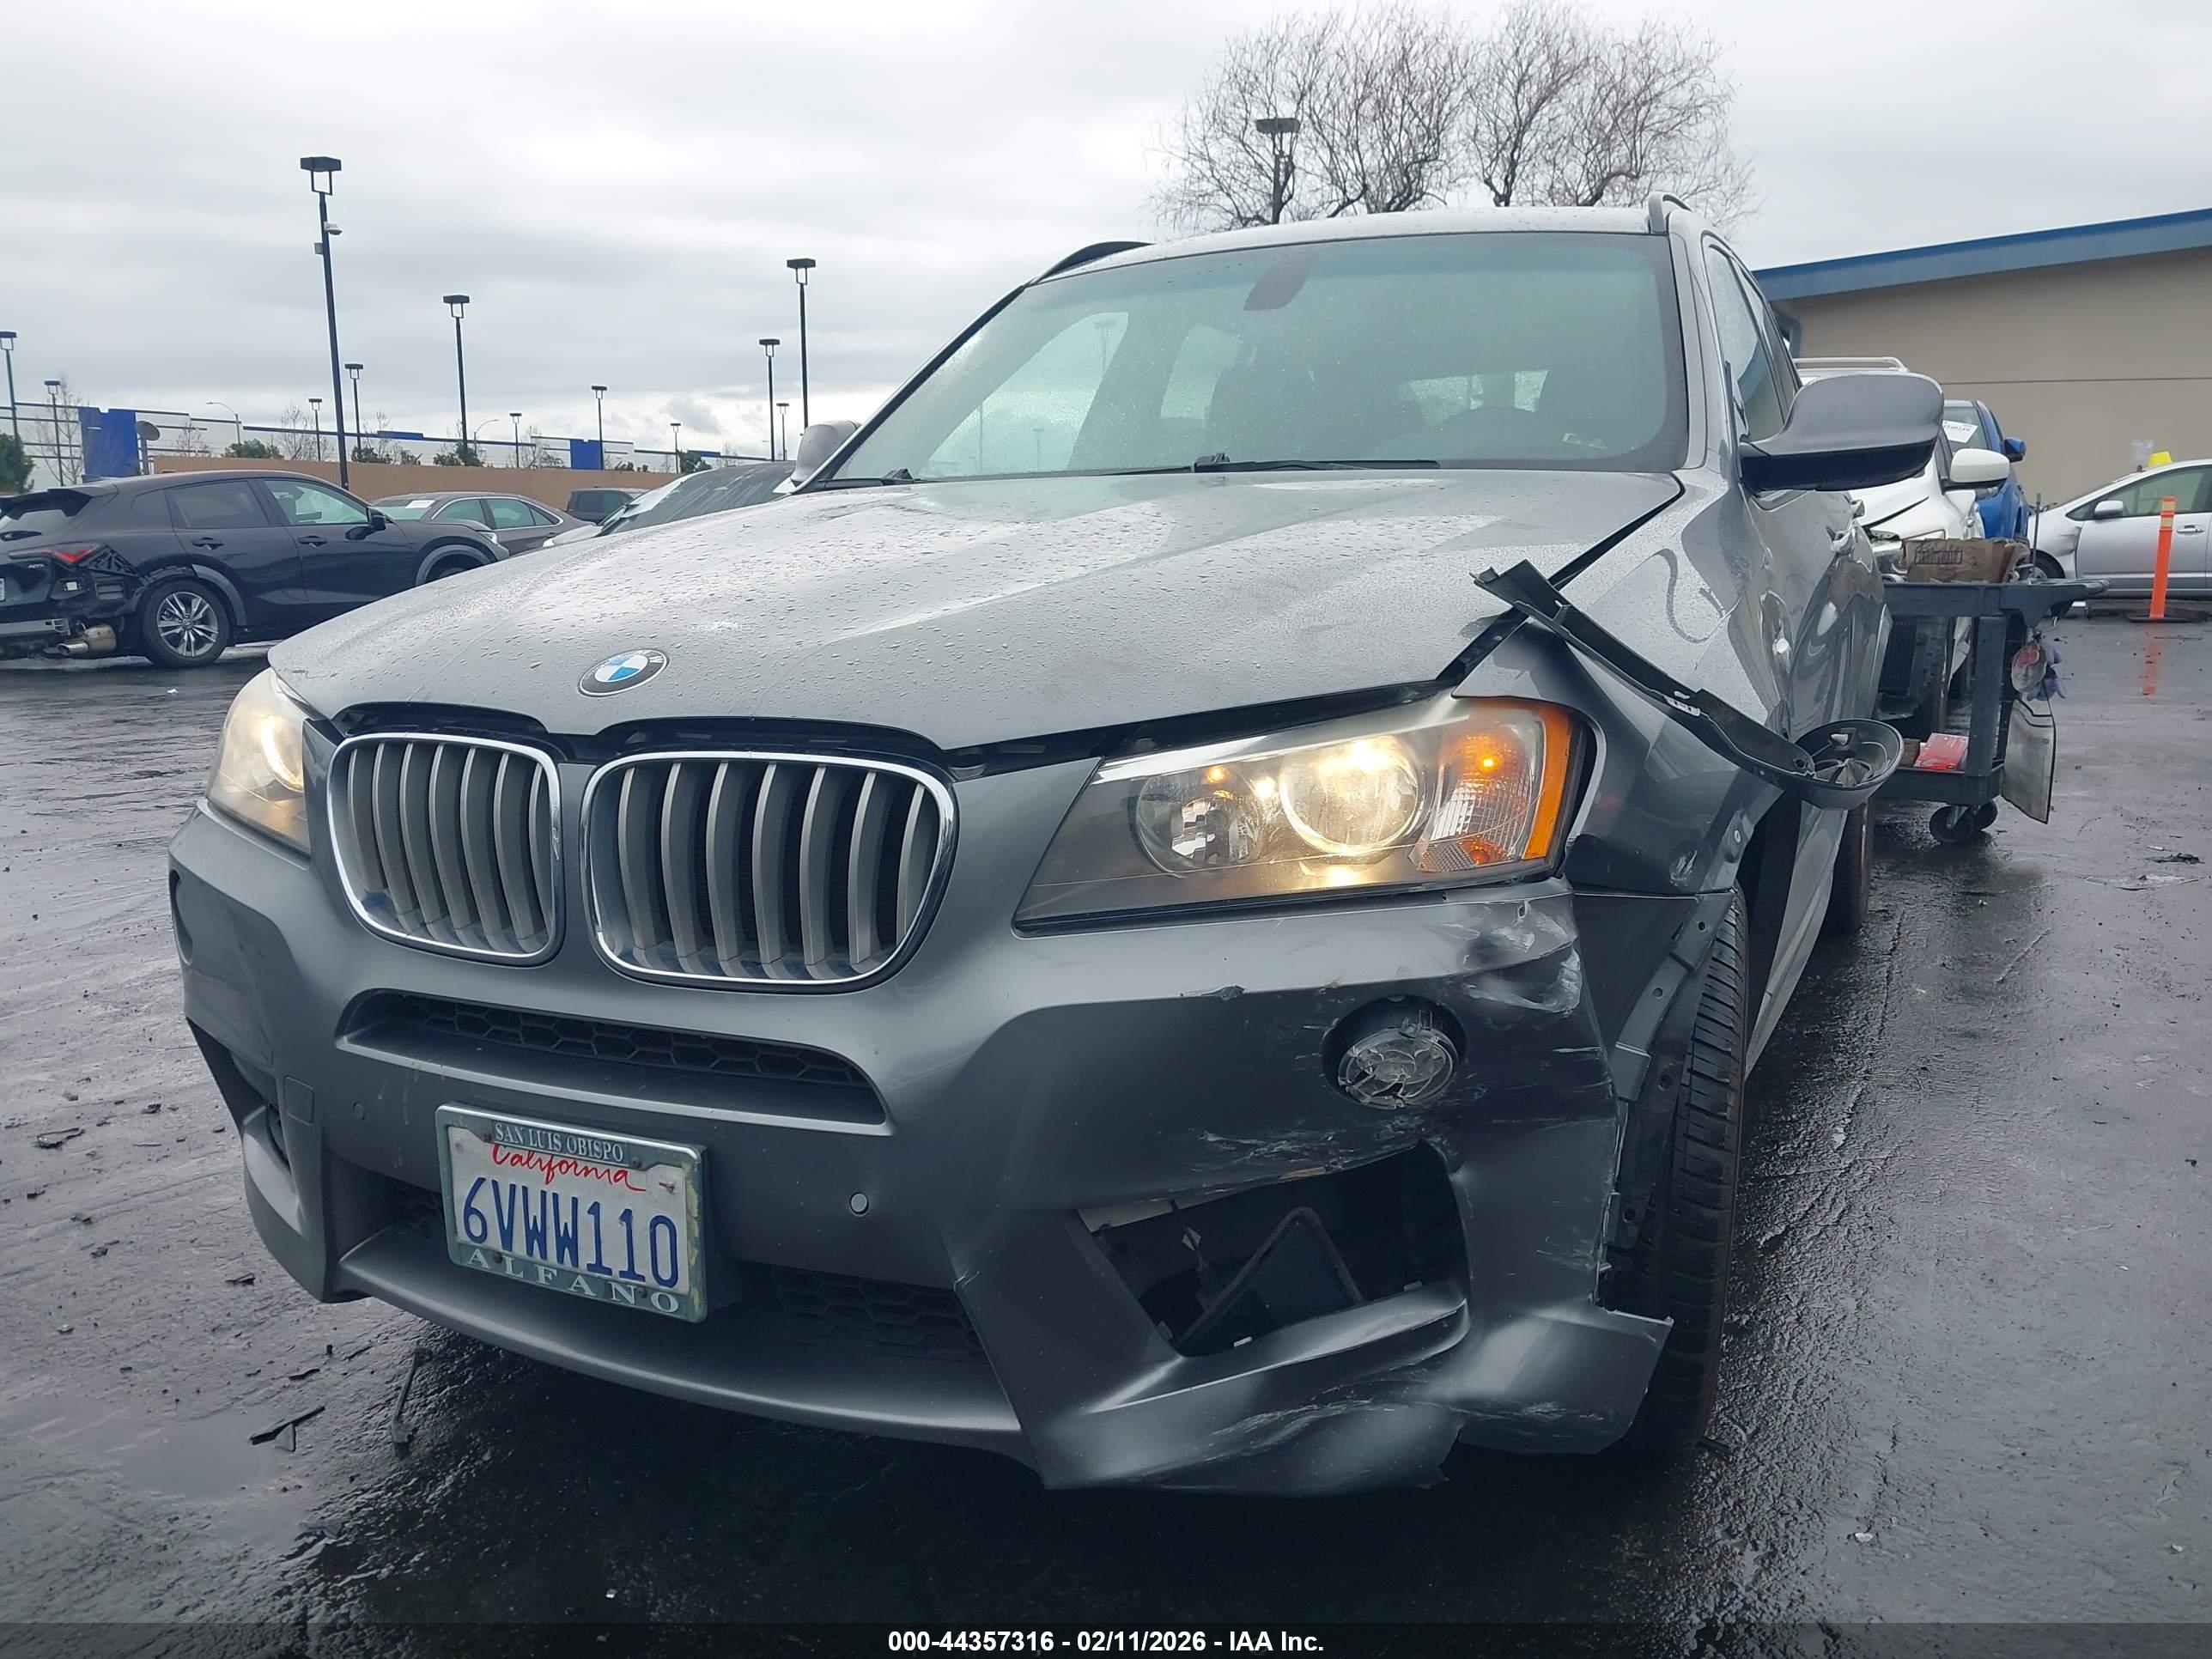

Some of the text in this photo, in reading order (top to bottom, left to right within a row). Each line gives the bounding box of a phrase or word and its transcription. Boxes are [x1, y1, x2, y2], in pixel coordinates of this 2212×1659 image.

[491, 1144, 647, 1192] California
[495, 1123, 624, 1163] SAN LUIS OBISPO
[463, 1176, 678, 1289] 6VWW110
[466, 1249, 679, 1313] ALFANO
